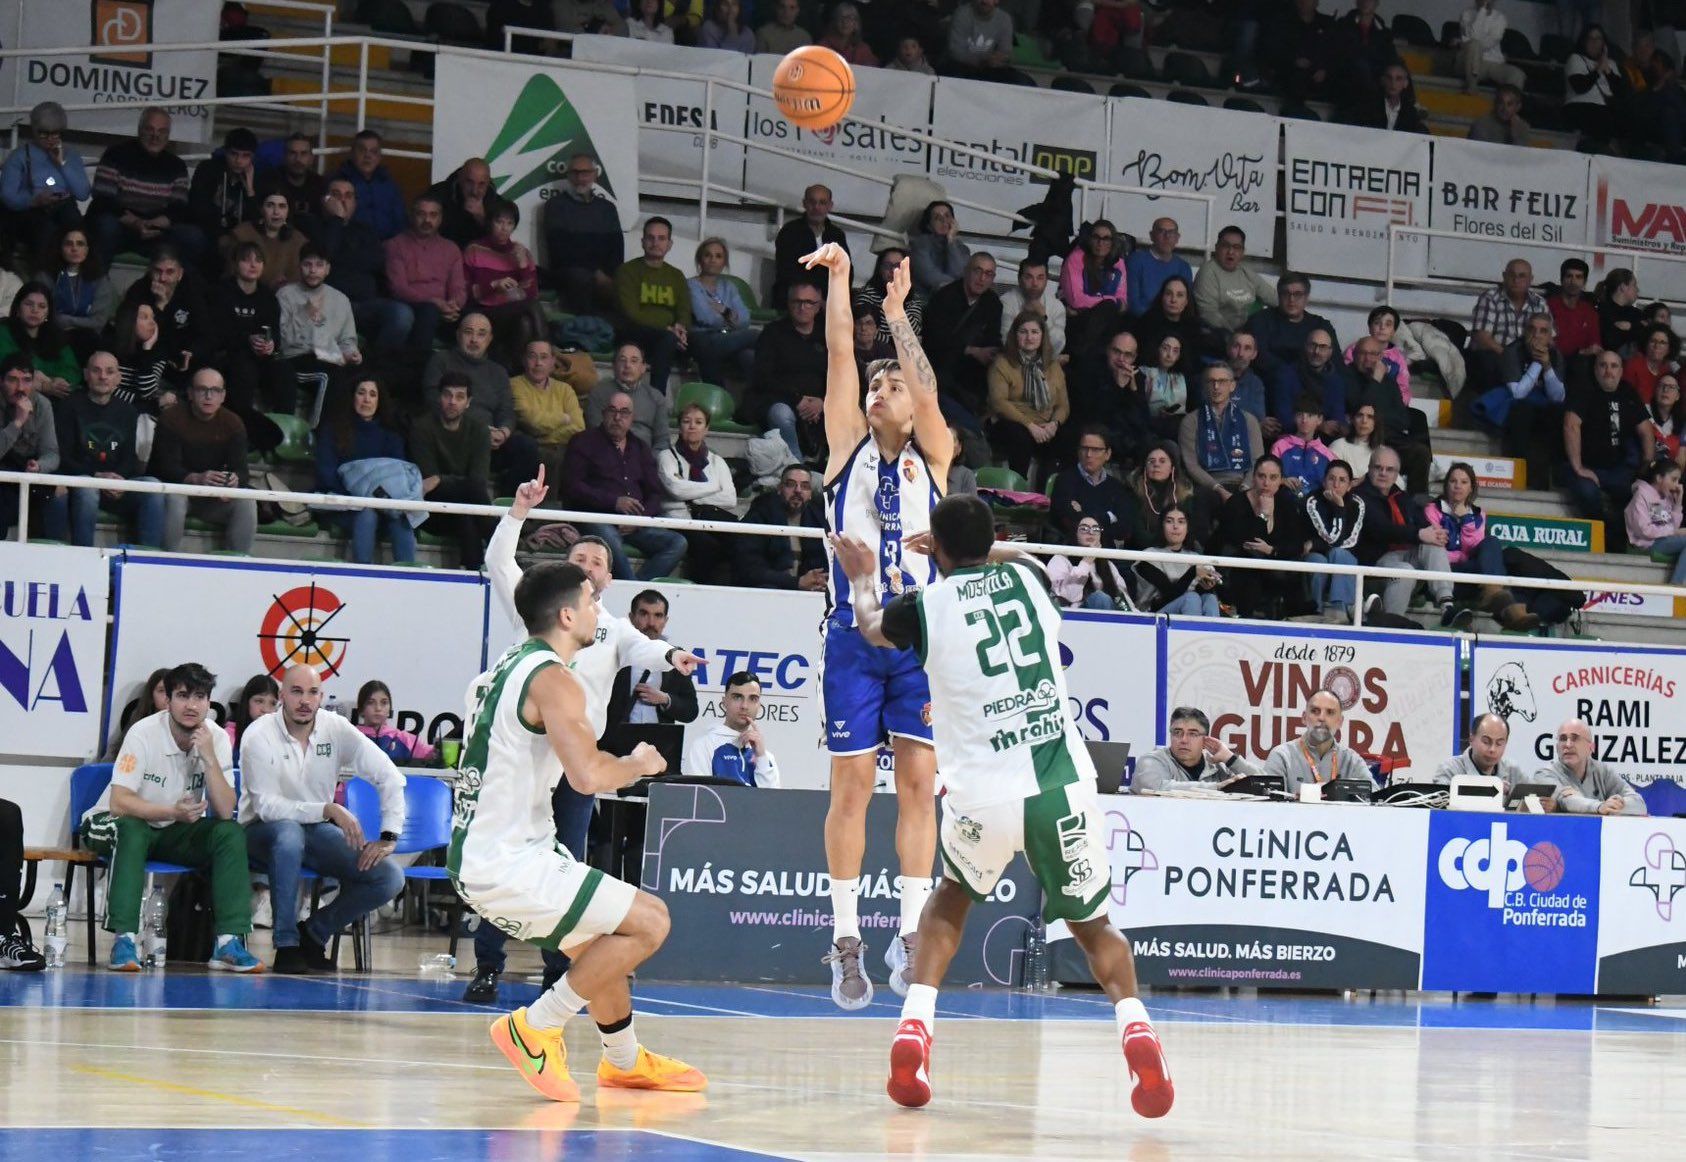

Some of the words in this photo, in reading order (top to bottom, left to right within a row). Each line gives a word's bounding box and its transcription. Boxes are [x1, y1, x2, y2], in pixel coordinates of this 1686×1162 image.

[29, 60, 209, 100] DOMINGUEZ
[754, 112, 787, 138] los
[1292, 158, 1420, 198] ENTRENA
[1230, 192, 1260, 213] Bar
[1291, 188, 1346, 219] CON
[1441, 181, 1500, 212] BAR
[1509, 189, 1577, 220] FELIZ
[1453, 214, 1505, 238] Flores
[1510, 221, 1536, 241] del
[1541, 223, 1563, 243] Sil
[641, 282, 675, 306] HH
[1490, 523, 1530, 543] CAJA
[1533, 527, 1588, 547] RURAL
[0, 580, 92, 621] UELA
[964, 600, 1042, 678] 22
[1274, 642, 1316, 661] desde
[1324, 645, 1356, 663] 1879
[1552, 666, 1677, 699] CARNICERÍAS
[983, 690, 1036, 717] PIEDRA
[1576, 698, 1650, 728] RAMI
[669, 862, 734, 894] MÁS
[1164, 866, 1395, 903] PONFERRADA
[1505, 892, 1526, 907] C.B.
[1529, 893, 1570, 909] Ciudad
[1573, 893, 1587, 909] de
[1503, 909, 1587, 928] Ponferrada
[1133, 937, 1171, 957] MÁS
[1174, 942, 1232, 959] SALUD.
[1235, 940, 1273, 960] MÁS
[1276, 945, 1336, 962] BIERZO
[1168, 967, 1302, 981] www.clinicaponferrada.es
